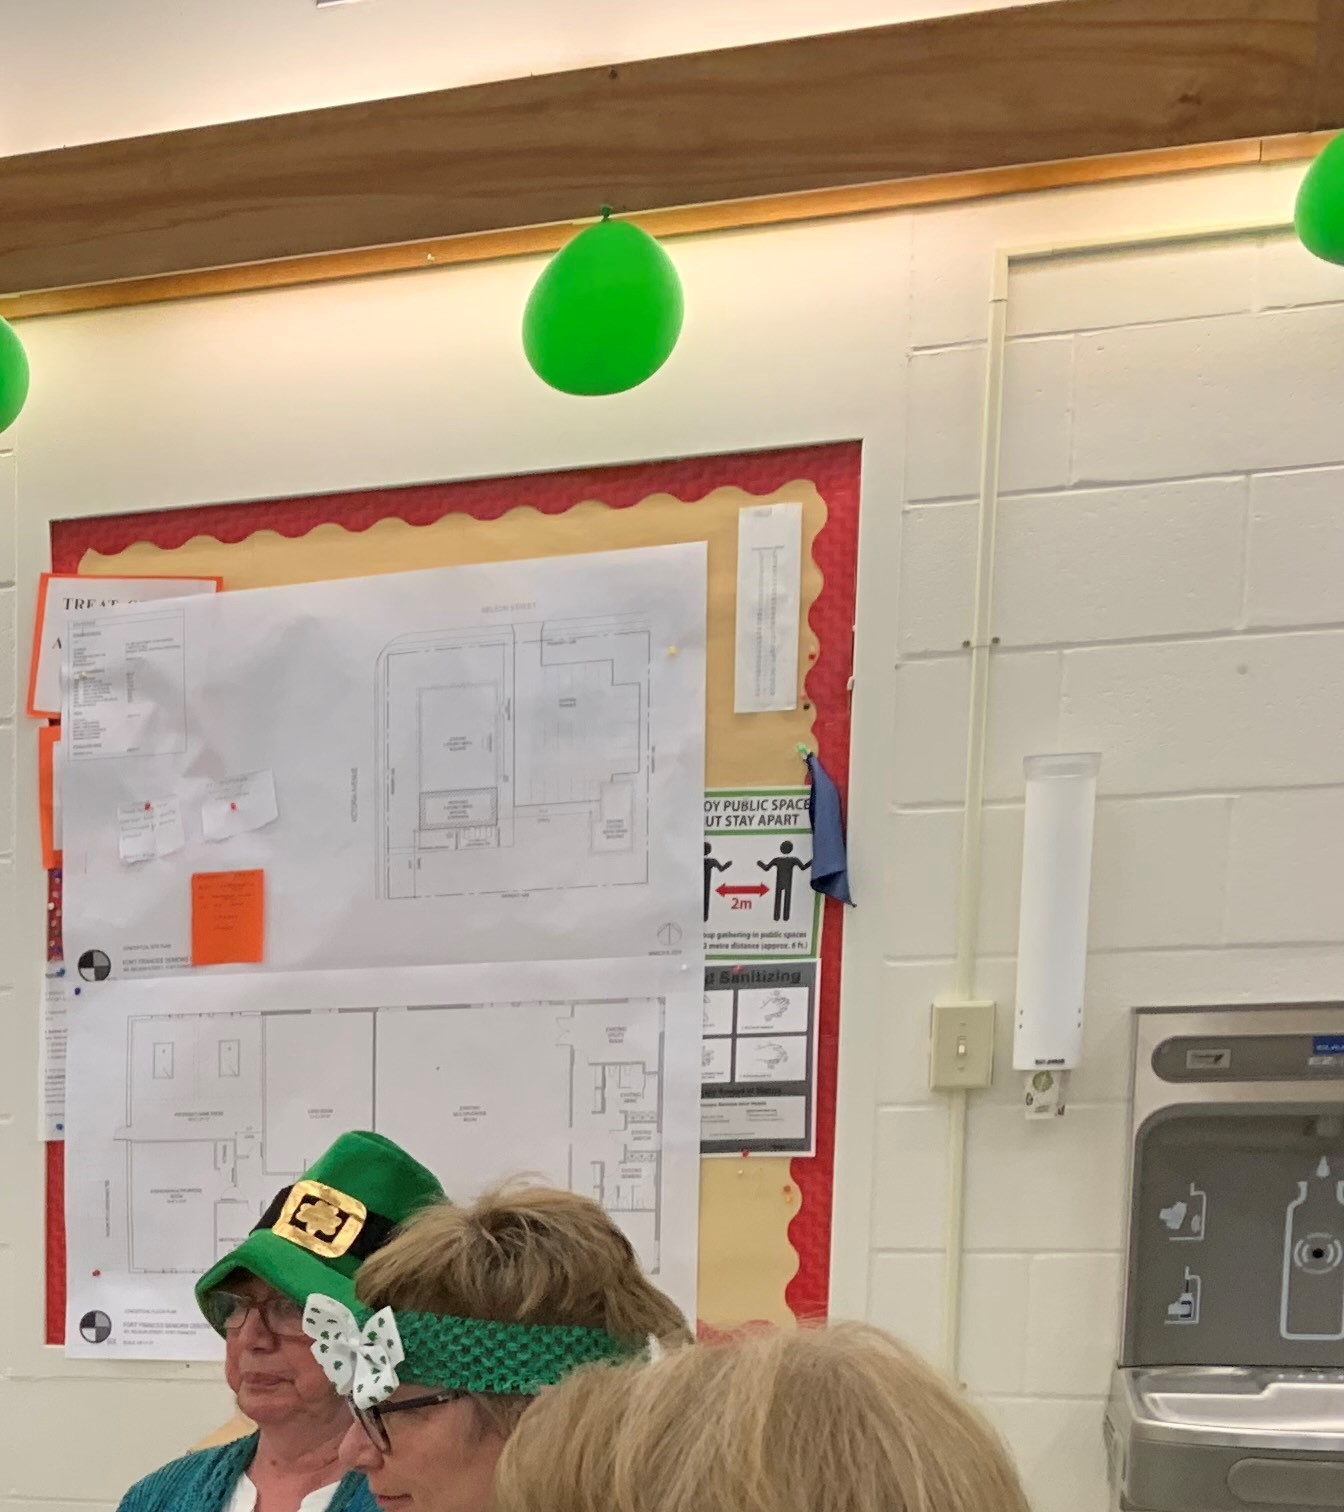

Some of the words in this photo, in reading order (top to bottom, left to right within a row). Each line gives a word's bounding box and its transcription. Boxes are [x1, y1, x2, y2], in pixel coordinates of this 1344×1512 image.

[723, 799, 769, 812] PUBLIC
[725, 814, 755, 827] STAY
[757, 813, 800, 826] APART
[731, 897, 752, 910] 2m
[716, 931, 752, 941] gathering
[753, 931, 759, 939] in
[760, 931, 782, 940] public
[783, 931, 807, 940] spaces
[708, 942, 729, 950] metre
[731, 941, 760, 950] distance
[719, 970, 801, 985] Sanitizing
